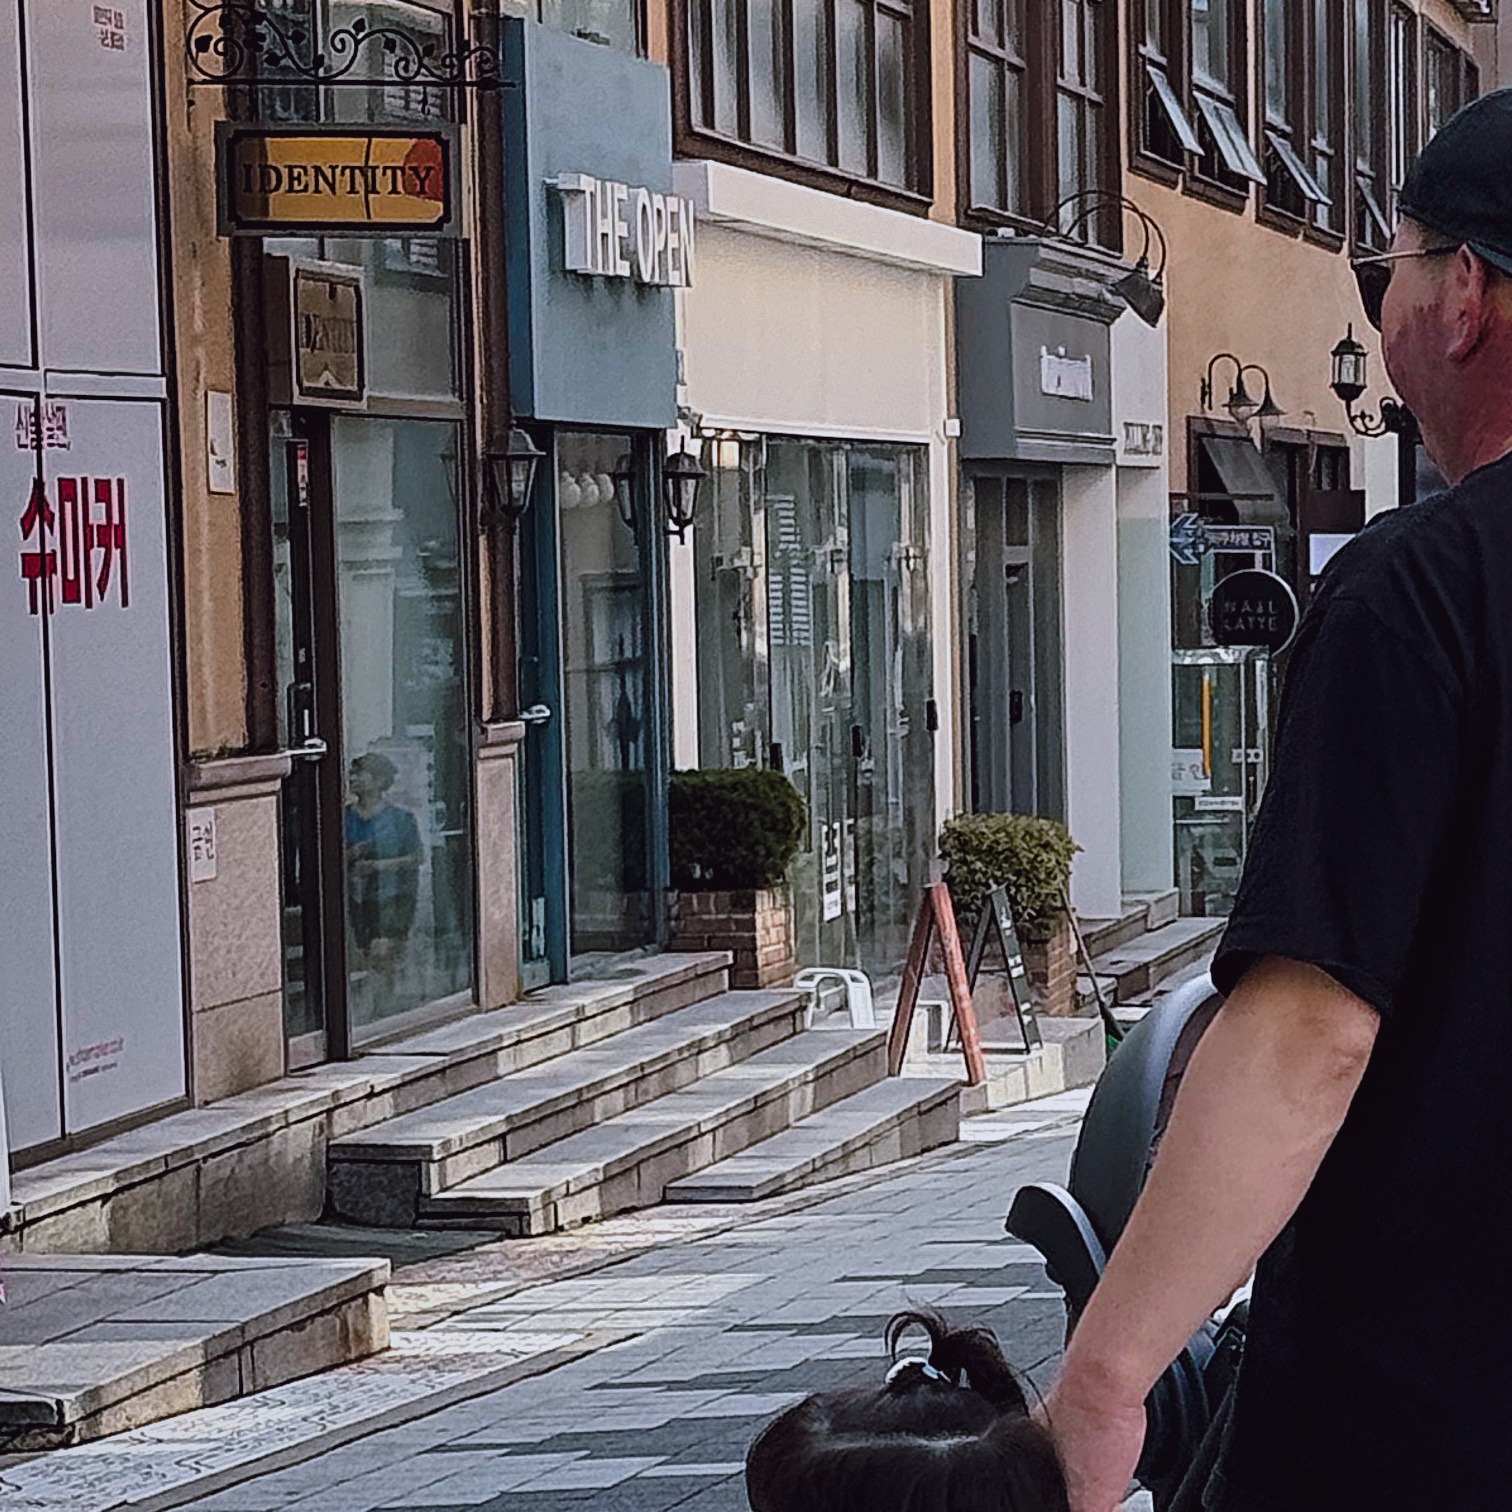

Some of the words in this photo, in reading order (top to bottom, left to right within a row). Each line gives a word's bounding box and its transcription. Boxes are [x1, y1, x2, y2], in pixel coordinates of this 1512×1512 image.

[243, 164, 434, 196] IDENTITY
[562, 174, 631, 278] THE
[637, 187, 695, 288] OPEN
[20, 476, 129, 615] 슈마커
